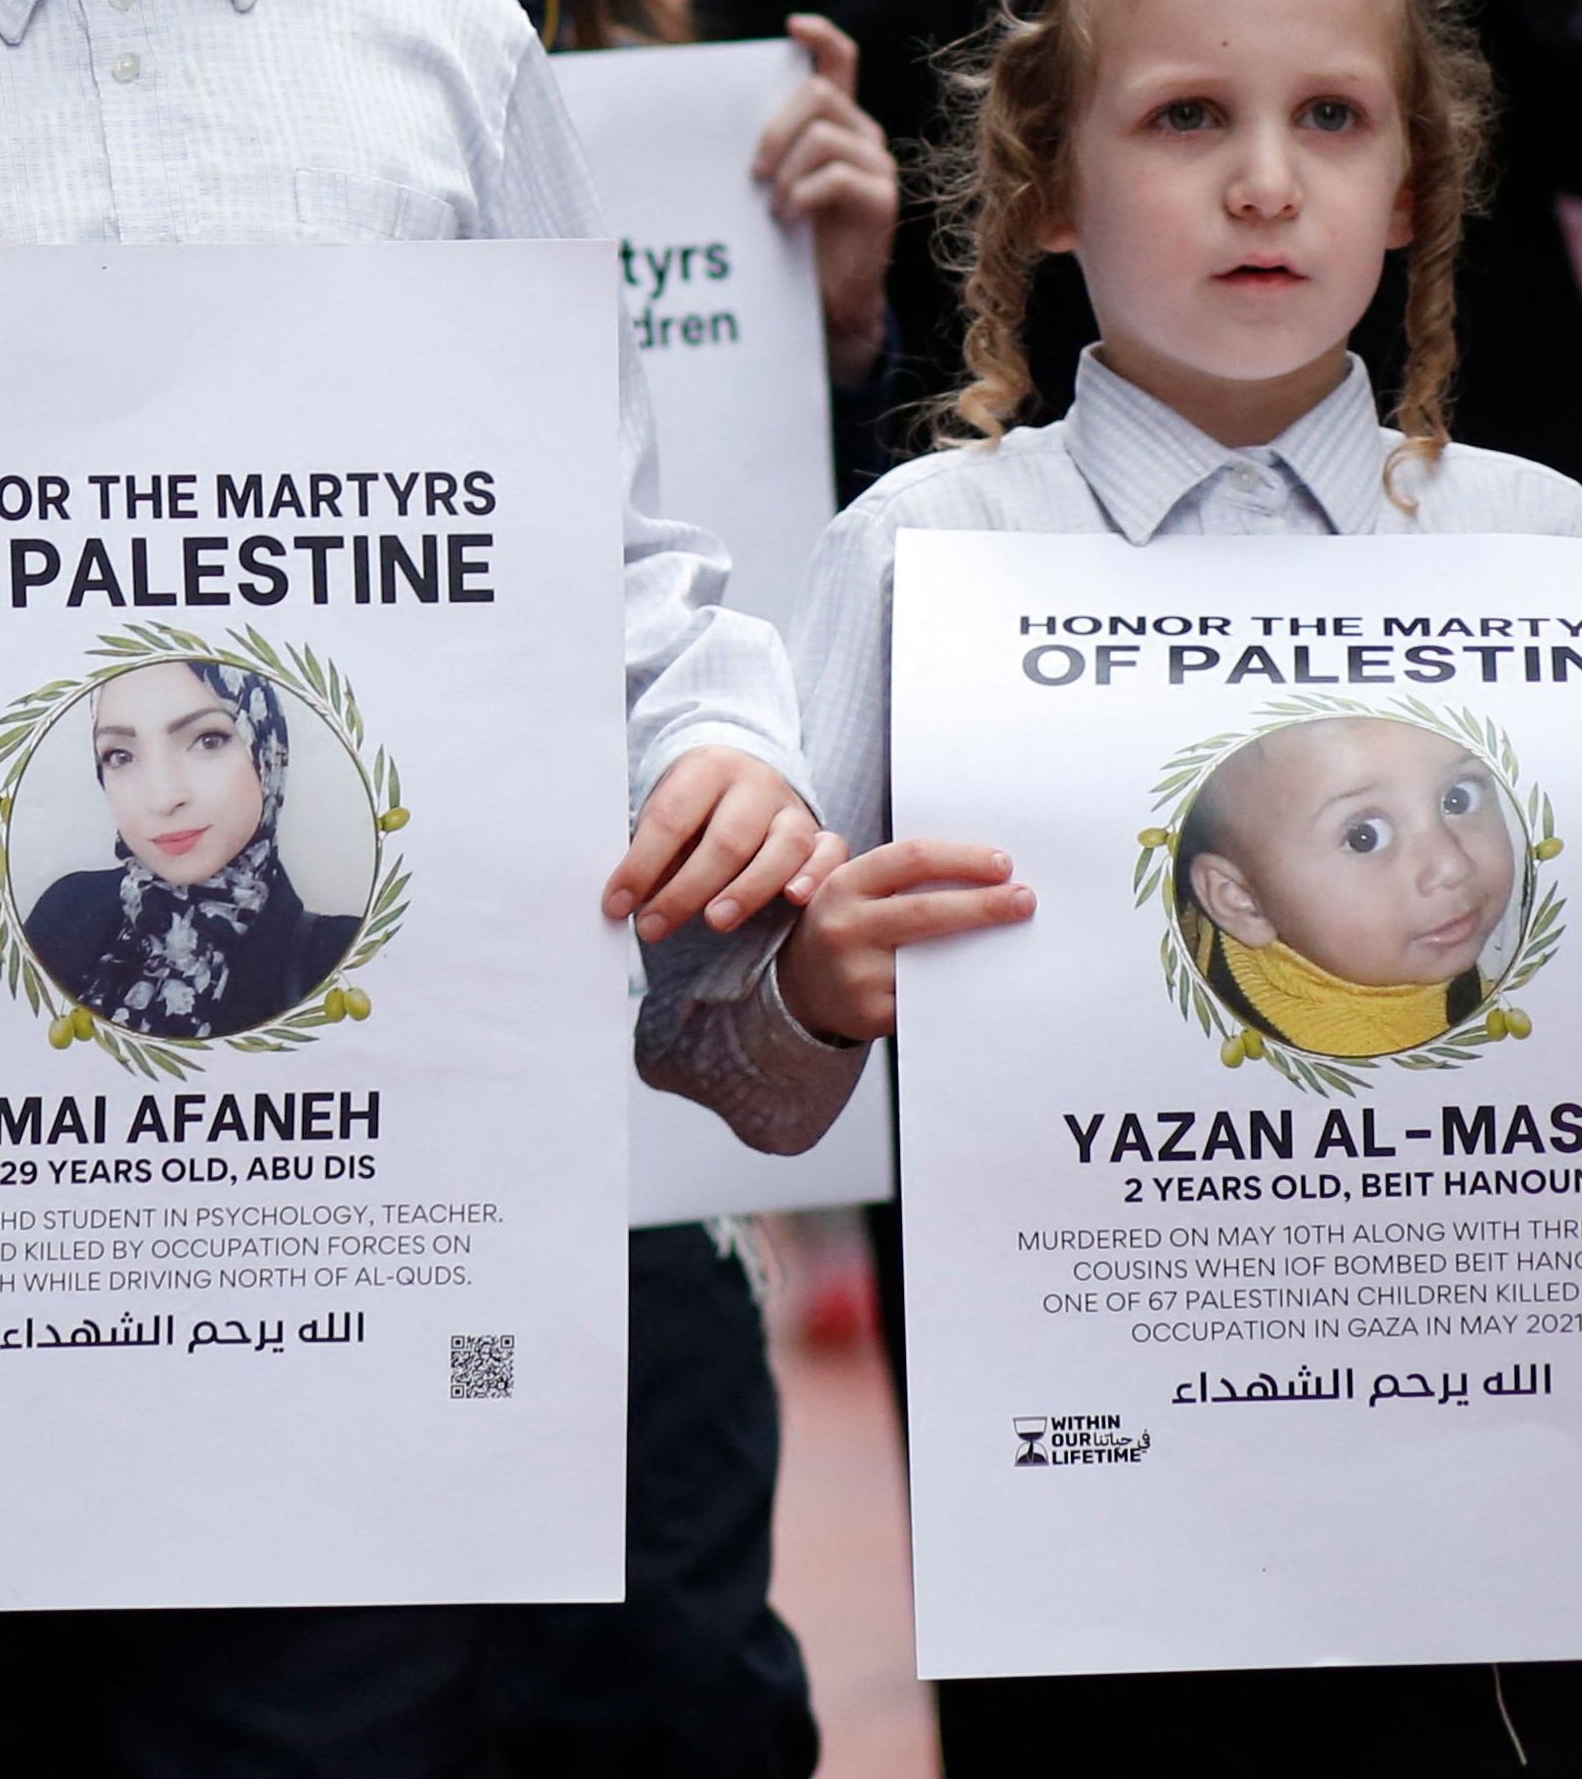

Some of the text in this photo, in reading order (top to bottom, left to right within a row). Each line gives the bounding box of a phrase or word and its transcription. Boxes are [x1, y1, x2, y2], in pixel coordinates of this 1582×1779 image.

[87, 474, 199, 520] THE
[216, 470, 497, 519] MARTYRS
[9, 533, 495, 609] PALESTINE
[1020, 615, 1232, 637] HONOR
[1251, 616, 1363, 637] THE
[1022, 644, 1141, 687] OF
[126, 1090, 380, 1144] AFANEH
[1063, 1109, 1294, 1164] YAZAN
[0, 1154, 376, 1186] 29 YEARS OLD, ABU DIS
[1124, 1177, 1143, 1203] 2
[1152, 1175, 1262, 1202] YEARS
[1271, 1173, 1351, 1203] OLD,
[1361, 1171, 1435, 1198] BEIT
[43, 1208, 157, 1230] STUDENT
[163, 1208, 188, 1228] IN
[196, 1205, 375, 1228] PSYCHOLOGY,
[381, 1203, 504, 1225] TEACHER.
[24, 1240, 105, 1262] KILLED
[112, 1239, 144, 1260] BY
[151, 1236, 319, 1260] OCCUPATION
[327, 1234, 426, 1256] FORCES
[432, 1234, 471, 1255] ON
[1018, 1220, 1582, 1251] MURDERED ON MAY 10TH ALONG WITH THR
[22, 1271, 101, 1293] WHILE
[109, 1269, 212, 1291] DRIVING
[219, 1267, 307, 1289] NORTH
[314, 1266, 348, 1288] OF
[354, 1265, 472, 1287] AL-QUDS.
[1073, 1258, 1188, 1282] COUSINS
[1194, 1257, 1276, 1279] WHEN
[1284, 1255, 1326, 1277] IOF
[1334, 1253, 1447, 1276] BOMBED
[1455, 1251, 1509, 1273] BEIT
[1042, 1281, 1580, 1314] ONE OF 67 PALESTINIAN CHILDREN KILLED
[187, 1320, 285, 1354] يرحم
[298, 1311, 364, 1343] الله
[1131, 1319, 1306, 1343] OCCUPATION
[1314, 1318, 1340, 1339] IN
[1347, 1316, 1419, 1338] GAZA
[1426, 1316, 1451, 1336] IN
[1460, 1314, 1518, 1335] MAY
[1171, 1363, 1552, 1408] الله يرحم الشهداء
[1051, 1415, 1120, 1430] WITHIN
[1052, 1432, 1091, 1447] OUR
[1052, 1448, 1141, 1465] LIFETIME
